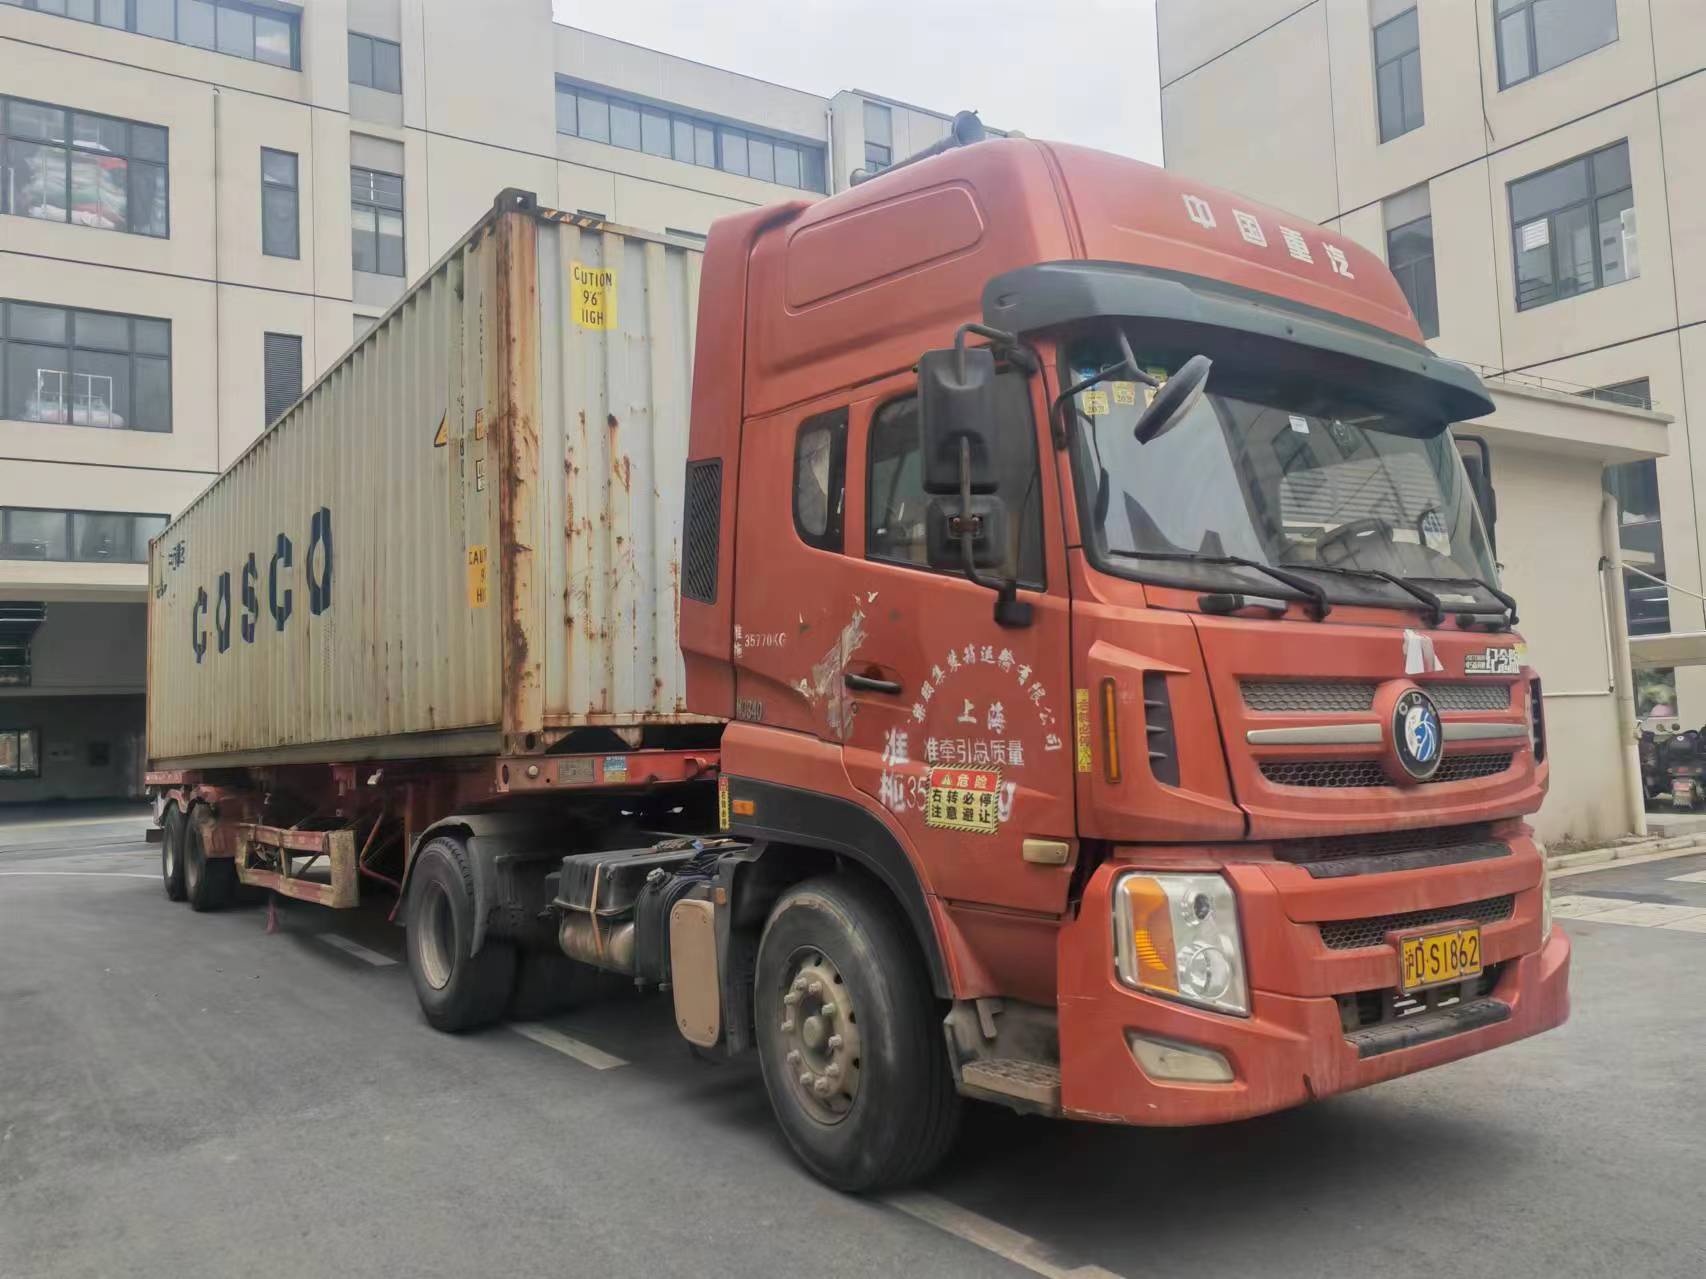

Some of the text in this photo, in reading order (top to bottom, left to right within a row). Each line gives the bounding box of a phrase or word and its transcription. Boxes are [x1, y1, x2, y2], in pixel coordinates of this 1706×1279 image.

[1182, 194, 1355, 280] 中国重汽
[193, 506, 333, 664] COSCO
[957, 699, 1006, 734] 上海
[924, 737, 1025, 766] 准牵引总质量
[956, 774, 988, 789] 危险
[931, 788, 993, 807] 右转必停
[931, 804, 992, 824] 注意避让
